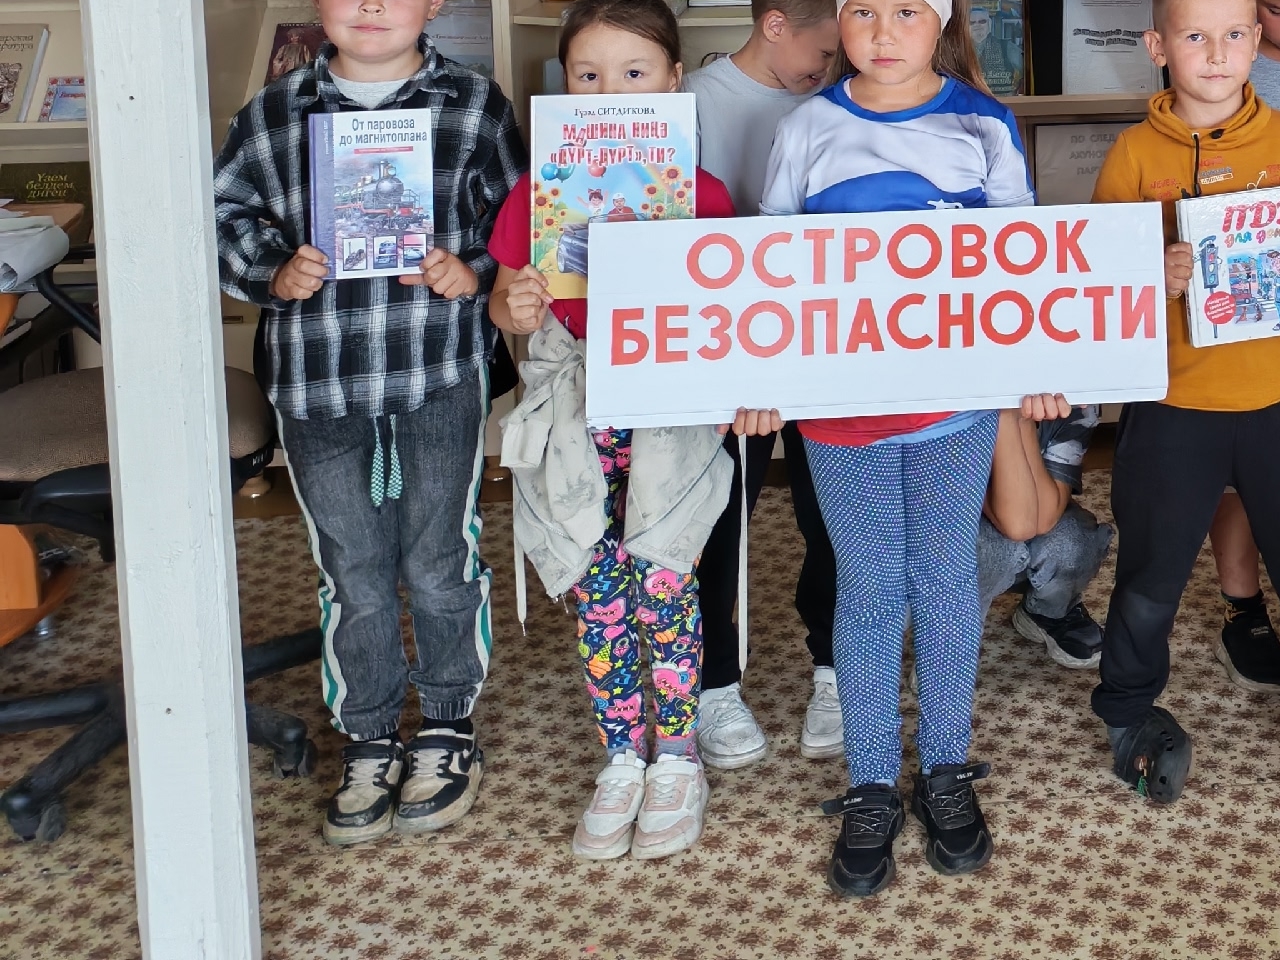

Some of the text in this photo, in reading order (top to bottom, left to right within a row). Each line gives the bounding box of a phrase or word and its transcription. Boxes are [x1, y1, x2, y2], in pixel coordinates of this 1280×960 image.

[339, 131, 428, 146] до магнитоплана
[352, 119, 415, 132] От паровоза
[686, 219, 1091, 289] ОСТРОВОК
[611, 285, 1157, 366] БЕЗОПАСНОСТИ
